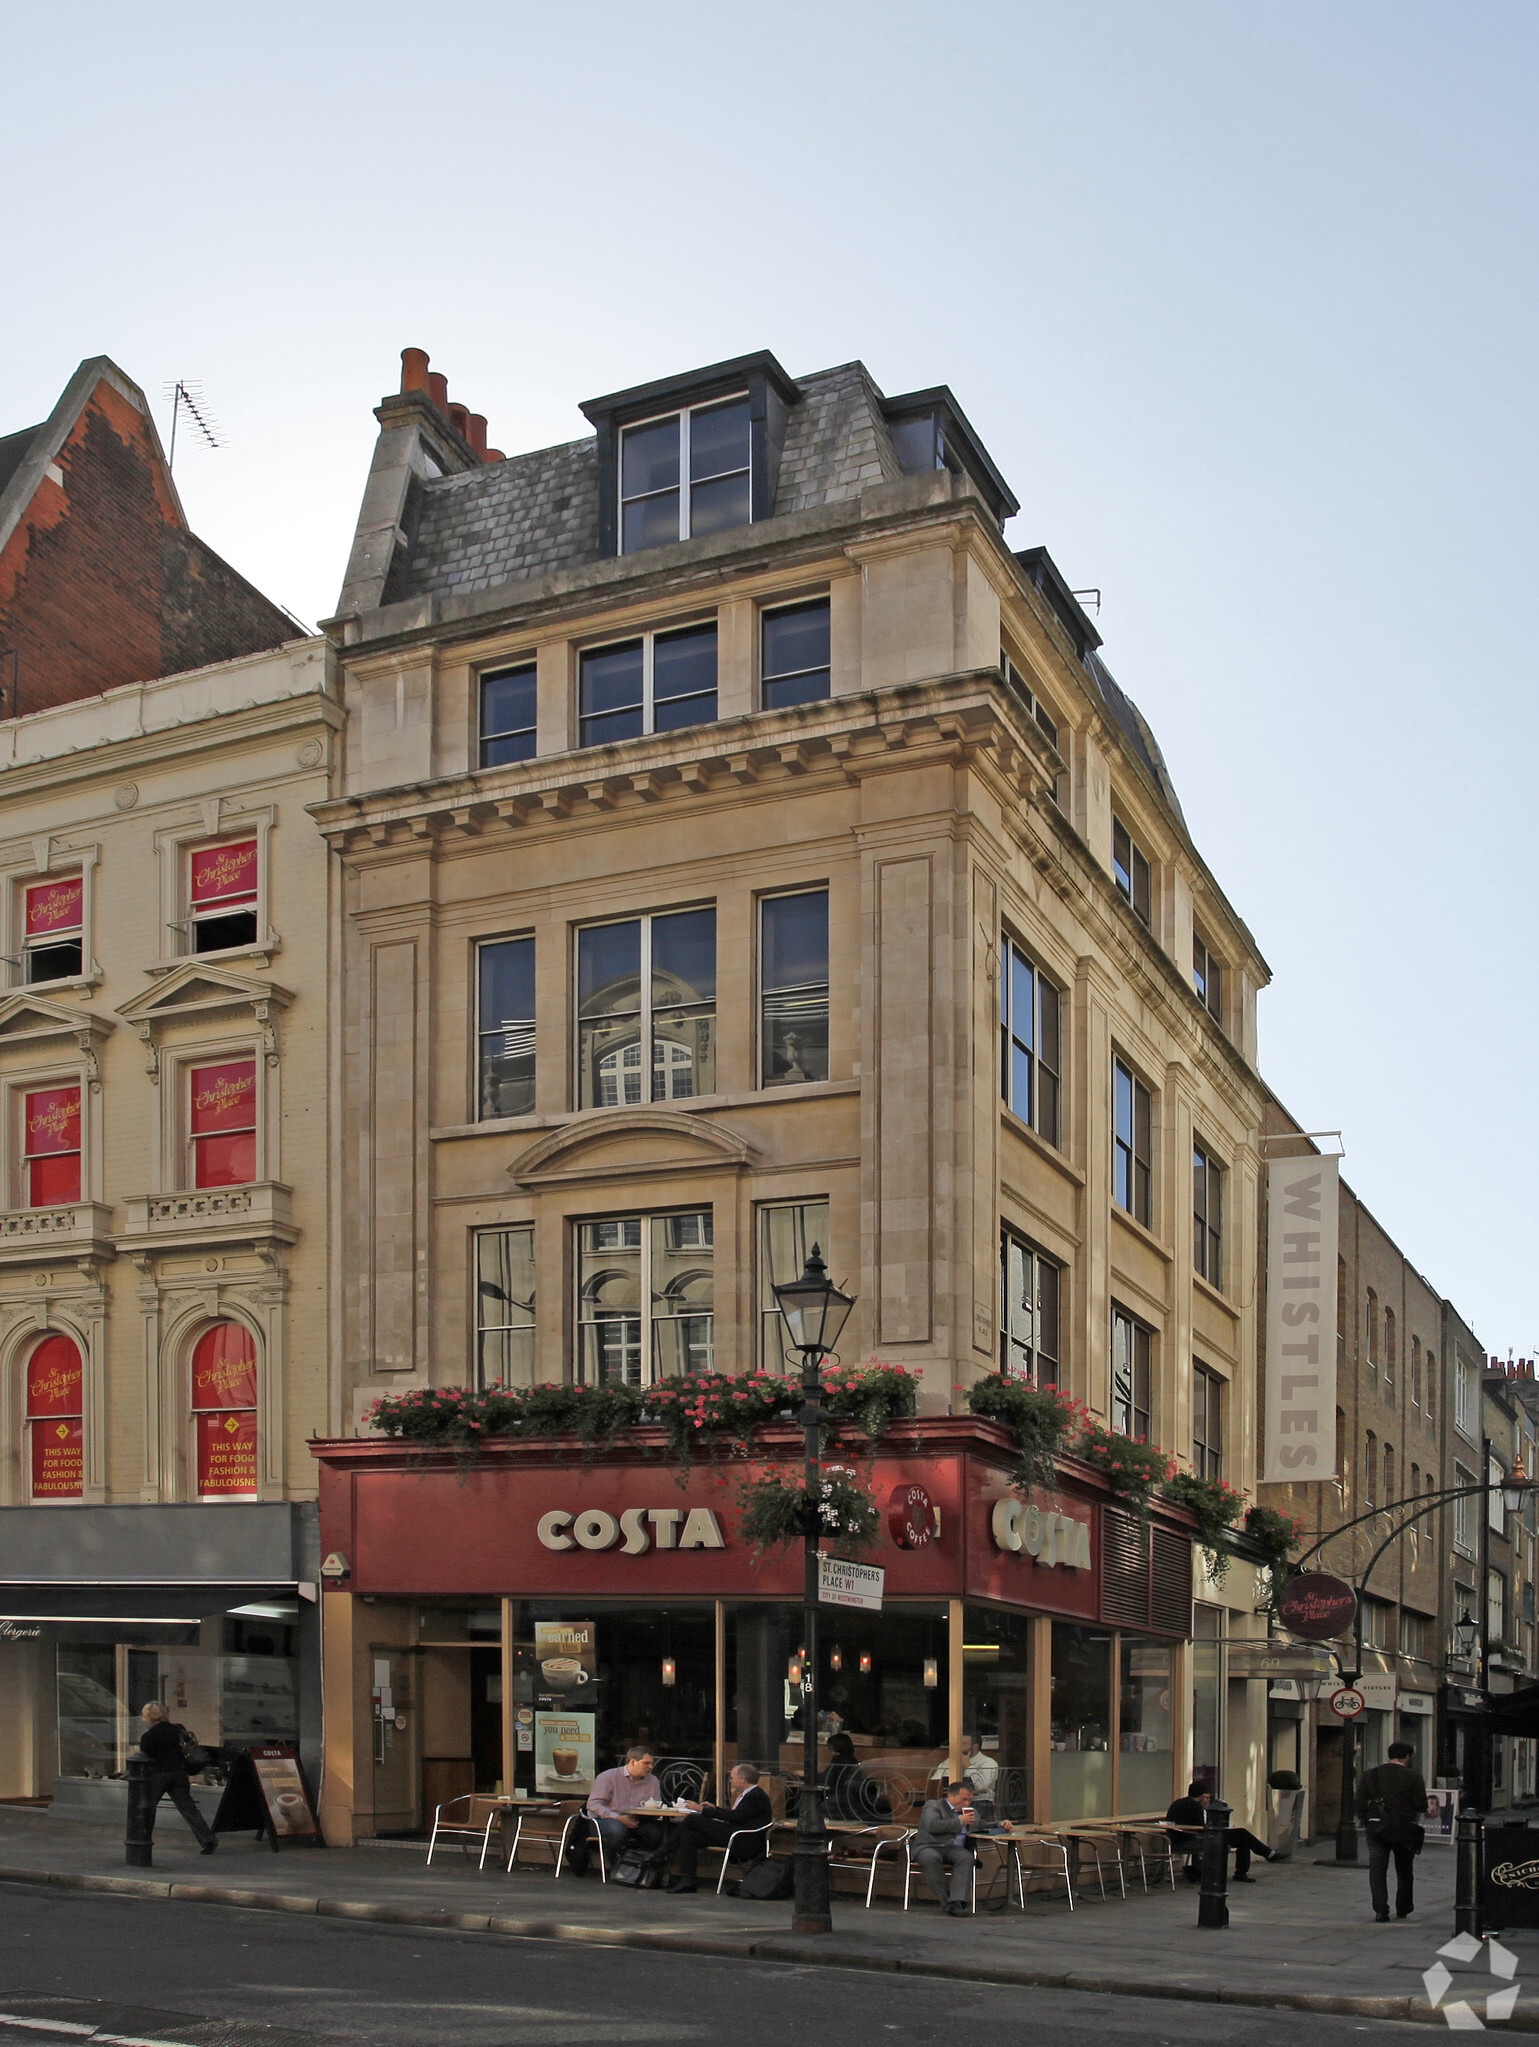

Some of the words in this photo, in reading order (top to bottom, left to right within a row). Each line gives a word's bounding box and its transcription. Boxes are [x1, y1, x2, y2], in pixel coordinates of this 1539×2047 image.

[1279, 1173, 1322, 1469] WHISTLES
[44, 1448, 61, 1456] THIS
[63, 1447, 81, 1455] WAY
[211, 1442, 230, 1451] THIS
[232, 1441, 253, 1450] WAY
[43, 1459, 58, 1467] FOR
[60, 1459, 82, 1467] FOOD
[210, 1455, 227, 1463] FOR
[229, 1454, 254, 1463] FOOD
[42, 1470, 76, 1479] FASHION
[209, 1466, 247, 1475] FASHION
[249, 1466, 256, 1474] &
[907, 1489, 928, 1508] COSTA
[537, 1508, 725, 1555] COSTA
[906, 1521, 931, 1546] COFFEE
[992, 1498, 1091, 1570] COSTA
[822, 1574, 843, 1589] PLACE
[845, 1578, 855, 1590] W1
[548, 1629, 589, 1643] earned
[562, 1643, 578, 1651] this
[1261, 1657, 1280, 1669] 69
[543, 1726, 558, 1735] you
[560, 1725, 580, 1734] need
[1508, 1866, 1539, 1880] NICH
